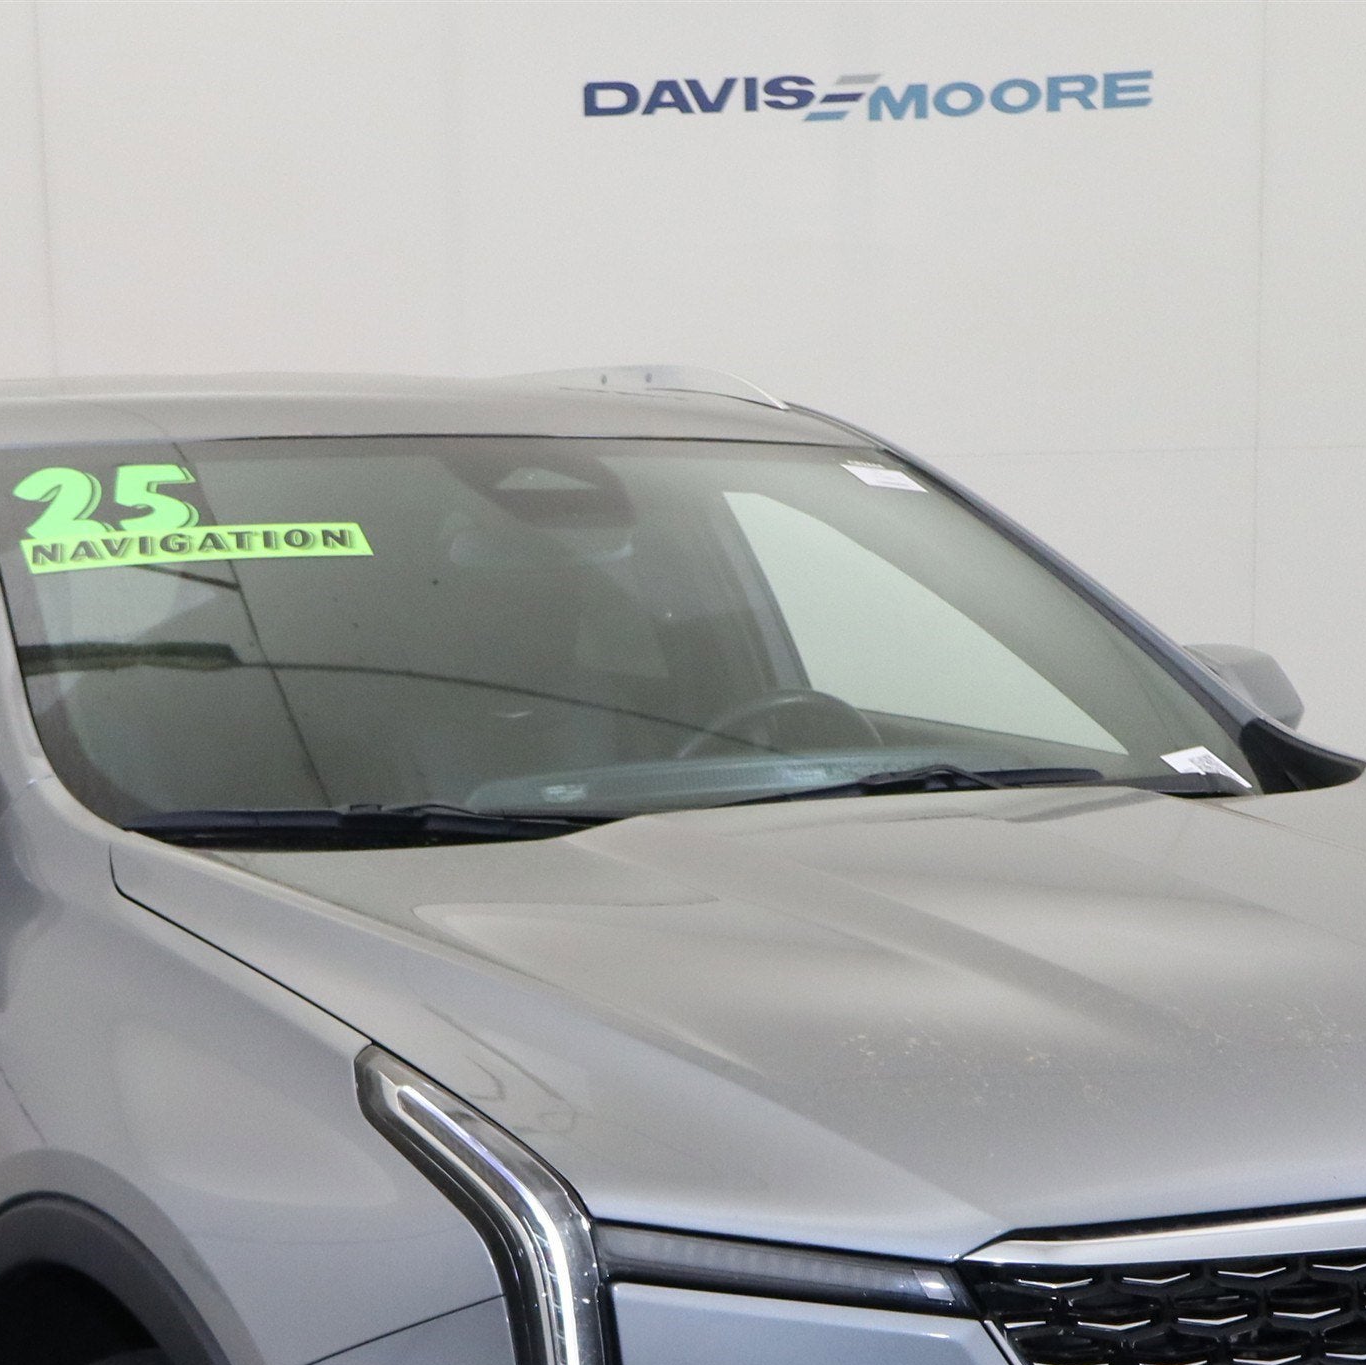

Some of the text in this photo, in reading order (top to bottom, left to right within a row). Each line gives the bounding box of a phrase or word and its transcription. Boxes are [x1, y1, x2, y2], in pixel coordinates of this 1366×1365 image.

[583, 69, 1153, 122] DAVIS MOORE
[13, 463, 200, 539] 25
[32, 527, 354, 566] NAVIGATION
